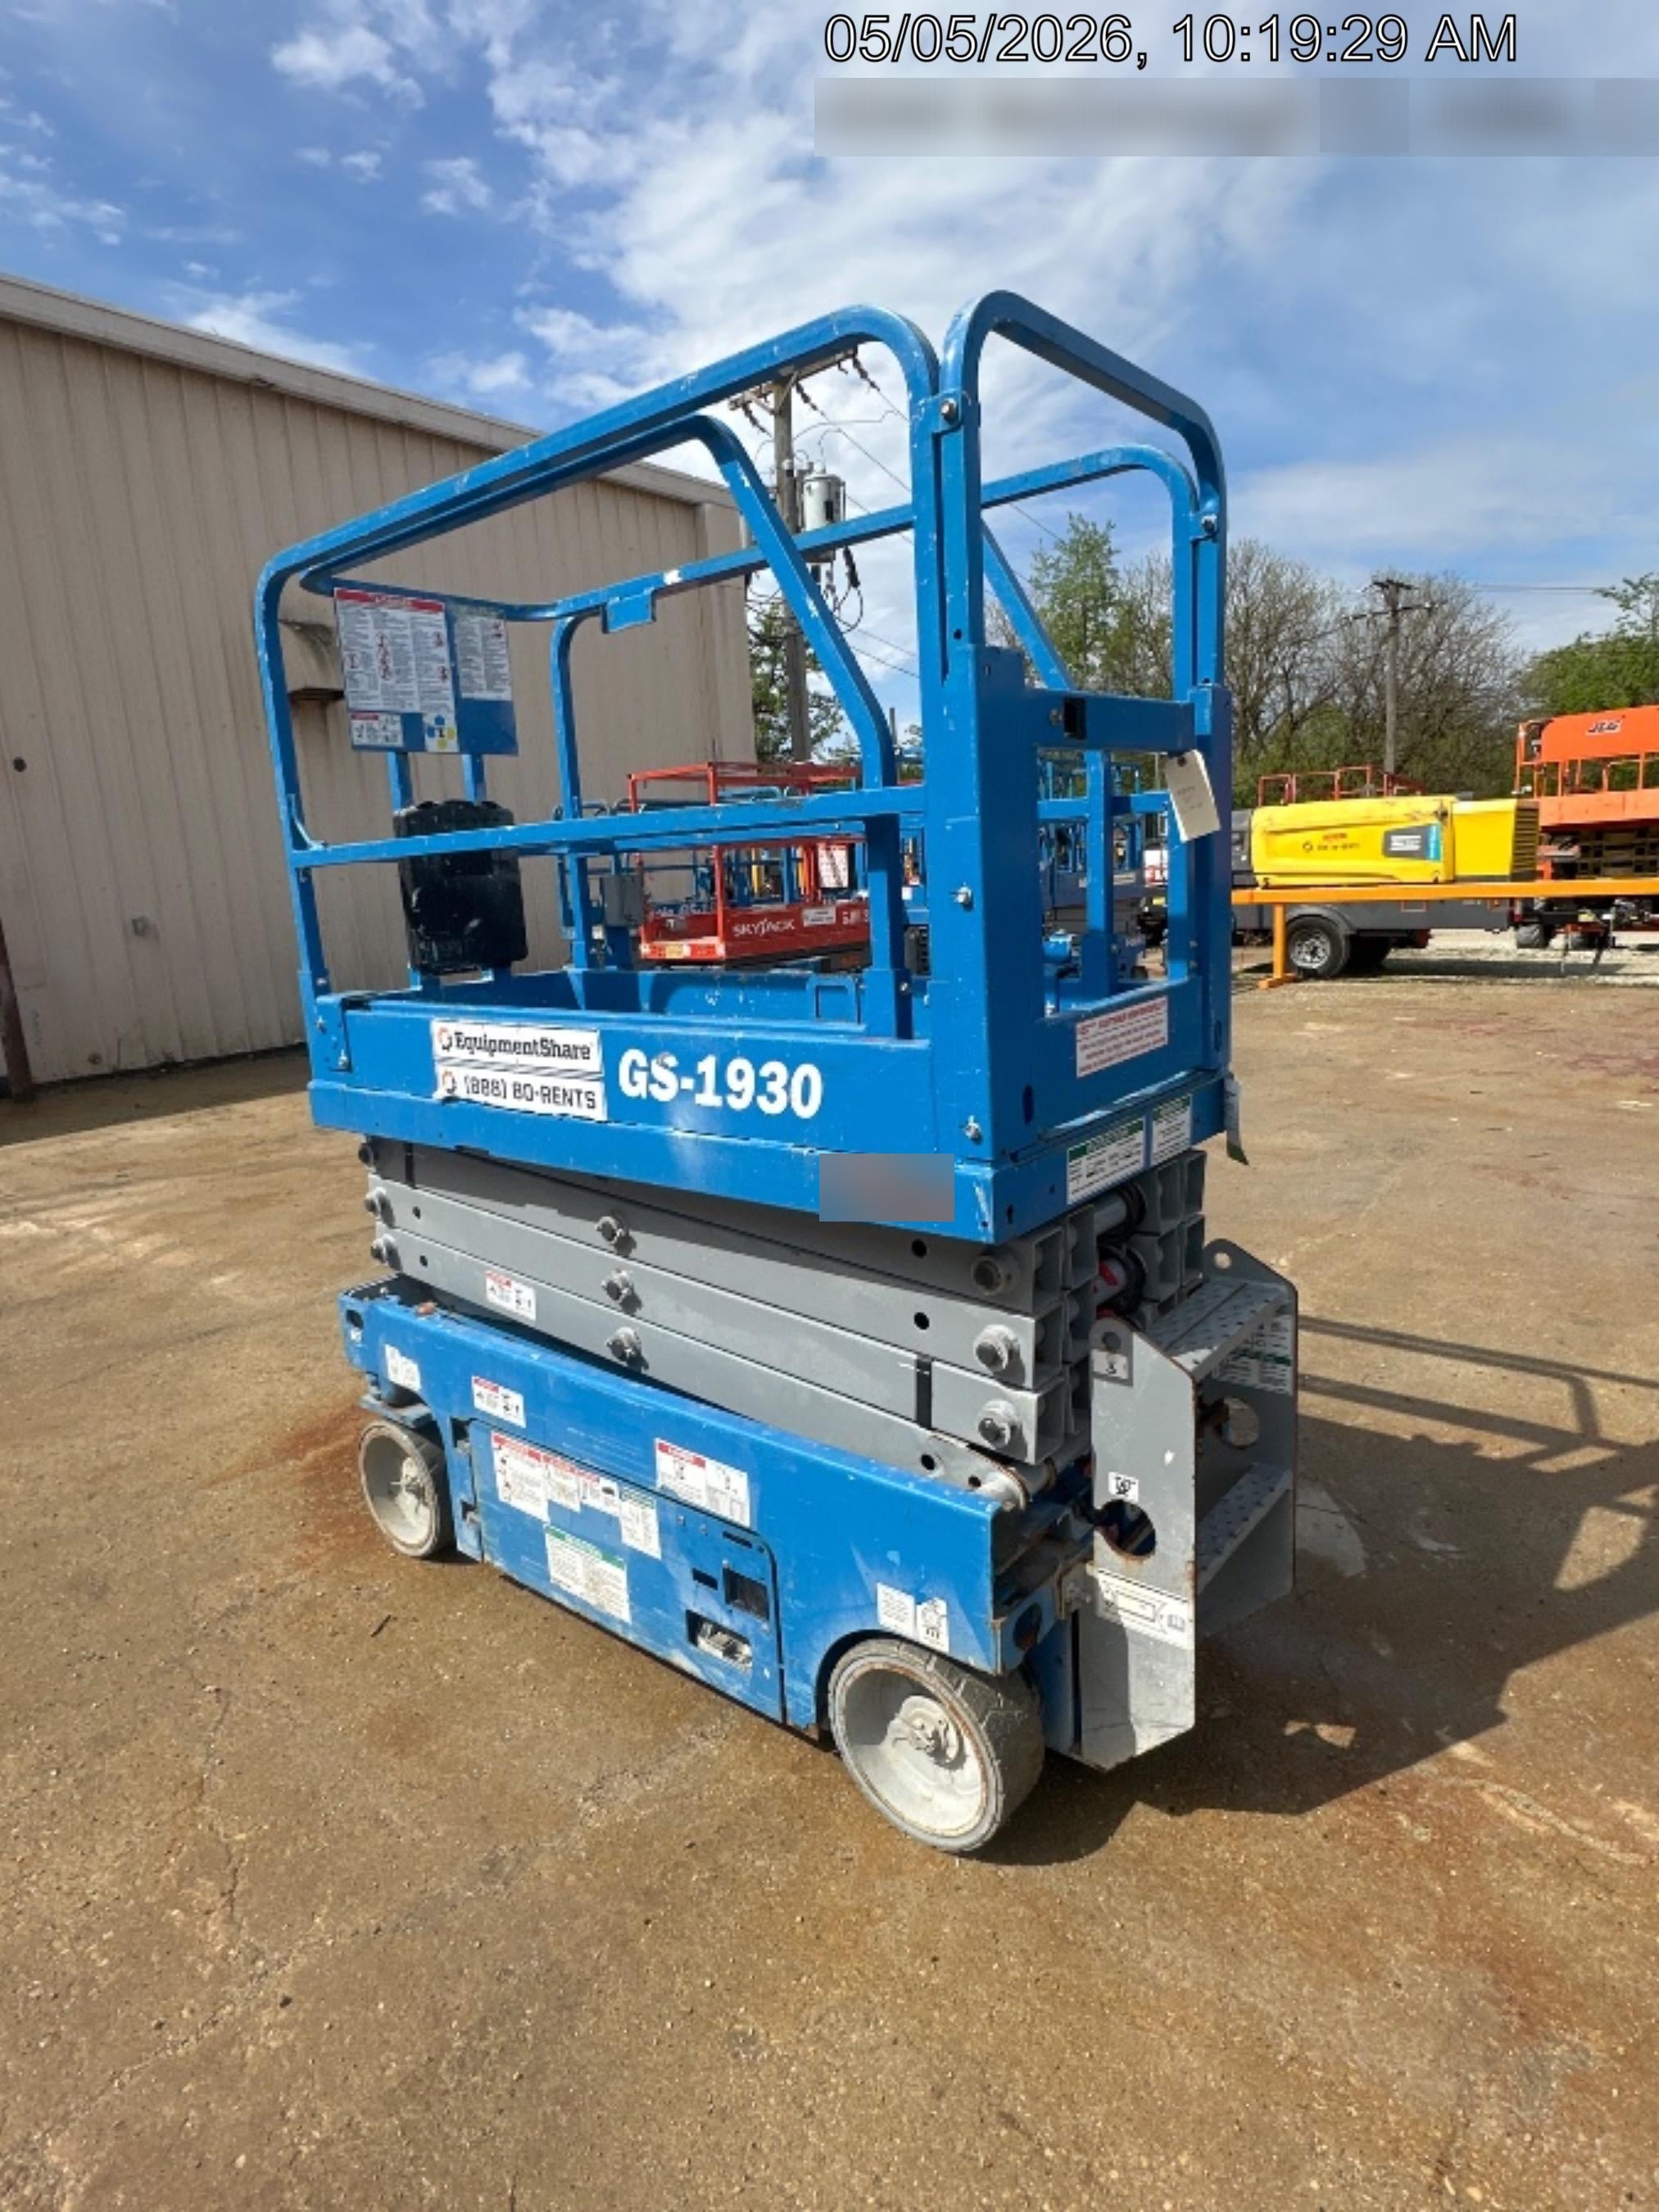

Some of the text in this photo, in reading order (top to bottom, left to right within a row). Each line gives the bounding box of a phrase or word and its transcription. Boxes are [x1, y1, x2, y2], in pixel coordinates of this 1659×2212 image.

[732, 917, 796, 937] SKYJACK
[454, 1031, 592, 1061] EquipmentShare
[464, 1074, 596, 1110] (888) 80-RENTS
[619, 1049, 823, 1119] GS-1930
